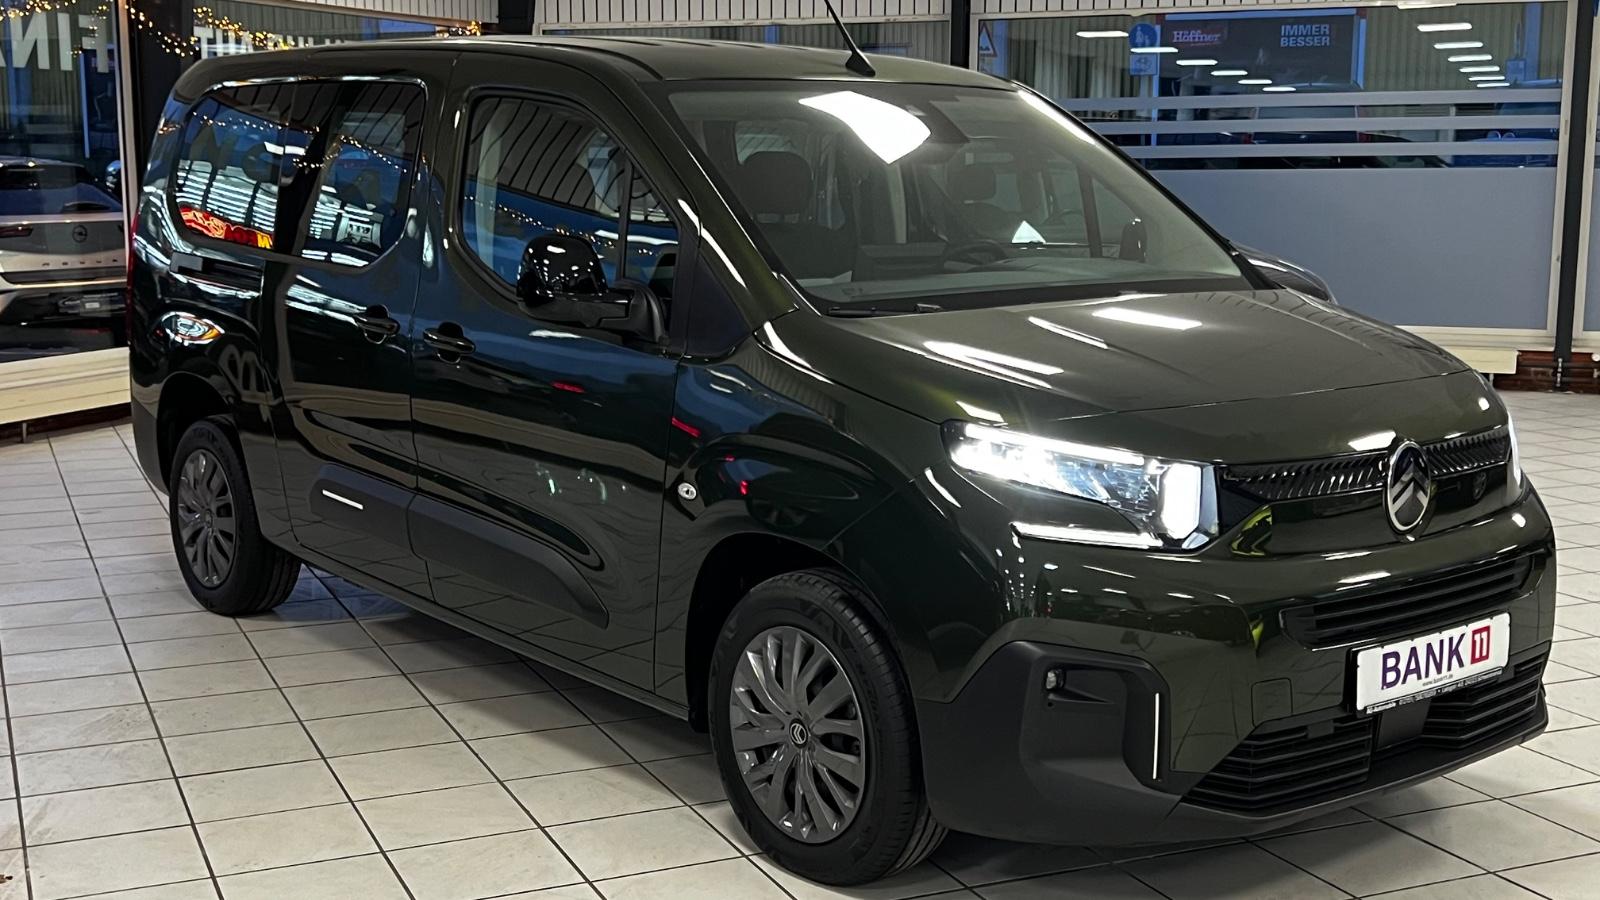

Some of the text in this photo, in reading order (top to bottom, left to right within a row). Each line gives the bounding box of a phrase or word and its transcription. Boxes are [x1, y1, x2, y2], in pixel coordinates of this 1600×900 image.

[1281, 24, 1329, 36] IMMER
[1172, 30, 1221, 43] Höffner
[1280, 36, 1330, 47] BESSER
[1381, 633, 1465, 690] BANK
